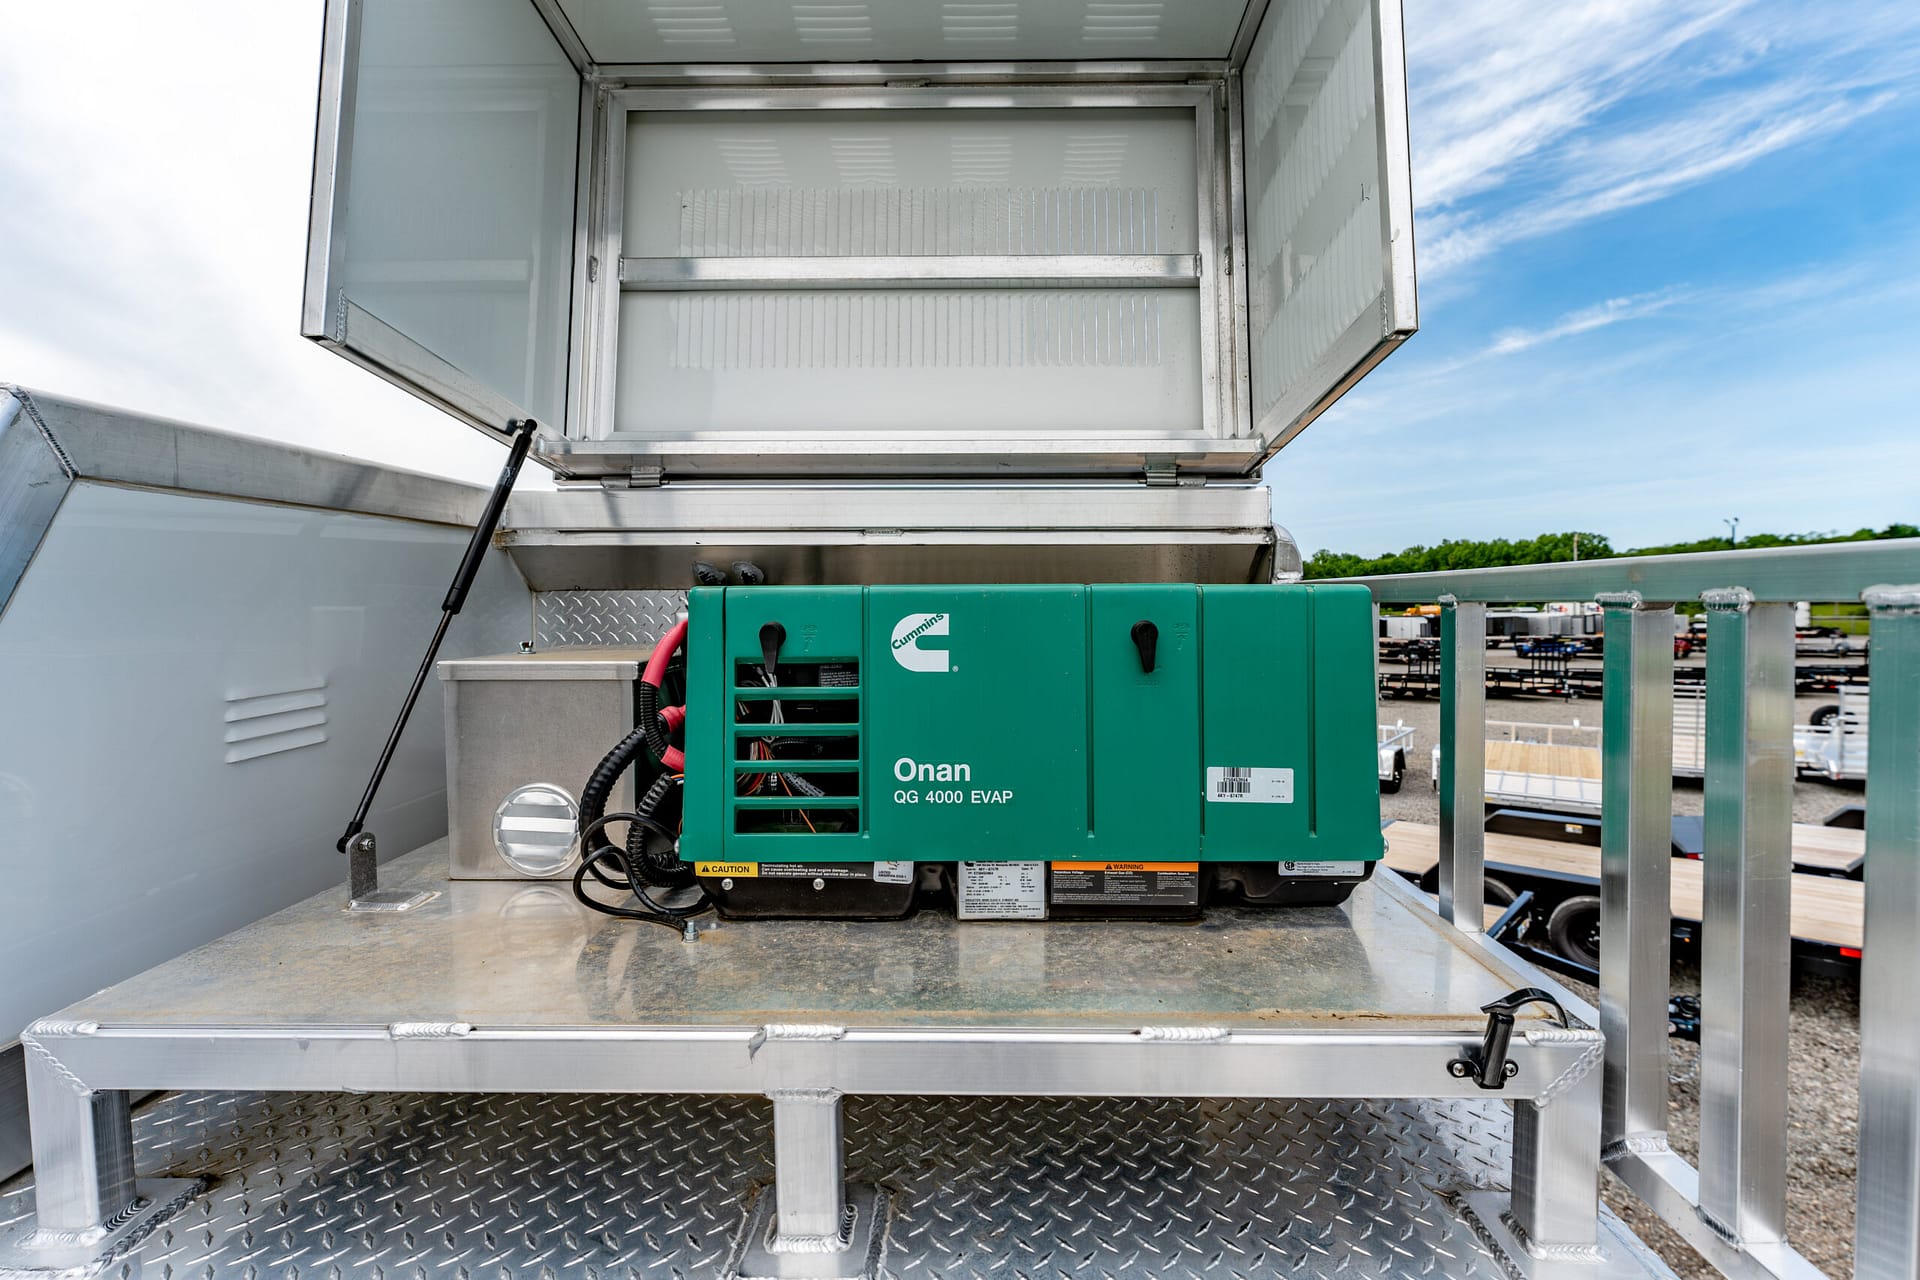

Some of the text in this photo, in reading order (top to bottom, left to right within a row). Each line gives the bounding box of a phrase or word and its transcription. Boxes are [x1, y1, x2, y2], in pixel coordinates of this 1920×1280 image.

[891, 613, 945, 650] Cummins
[894, 757, 971, 782] Onan
[894, 790, 1013, 804] QG 4000 EVAP
[711, 865, 750, 873] CAUTION
